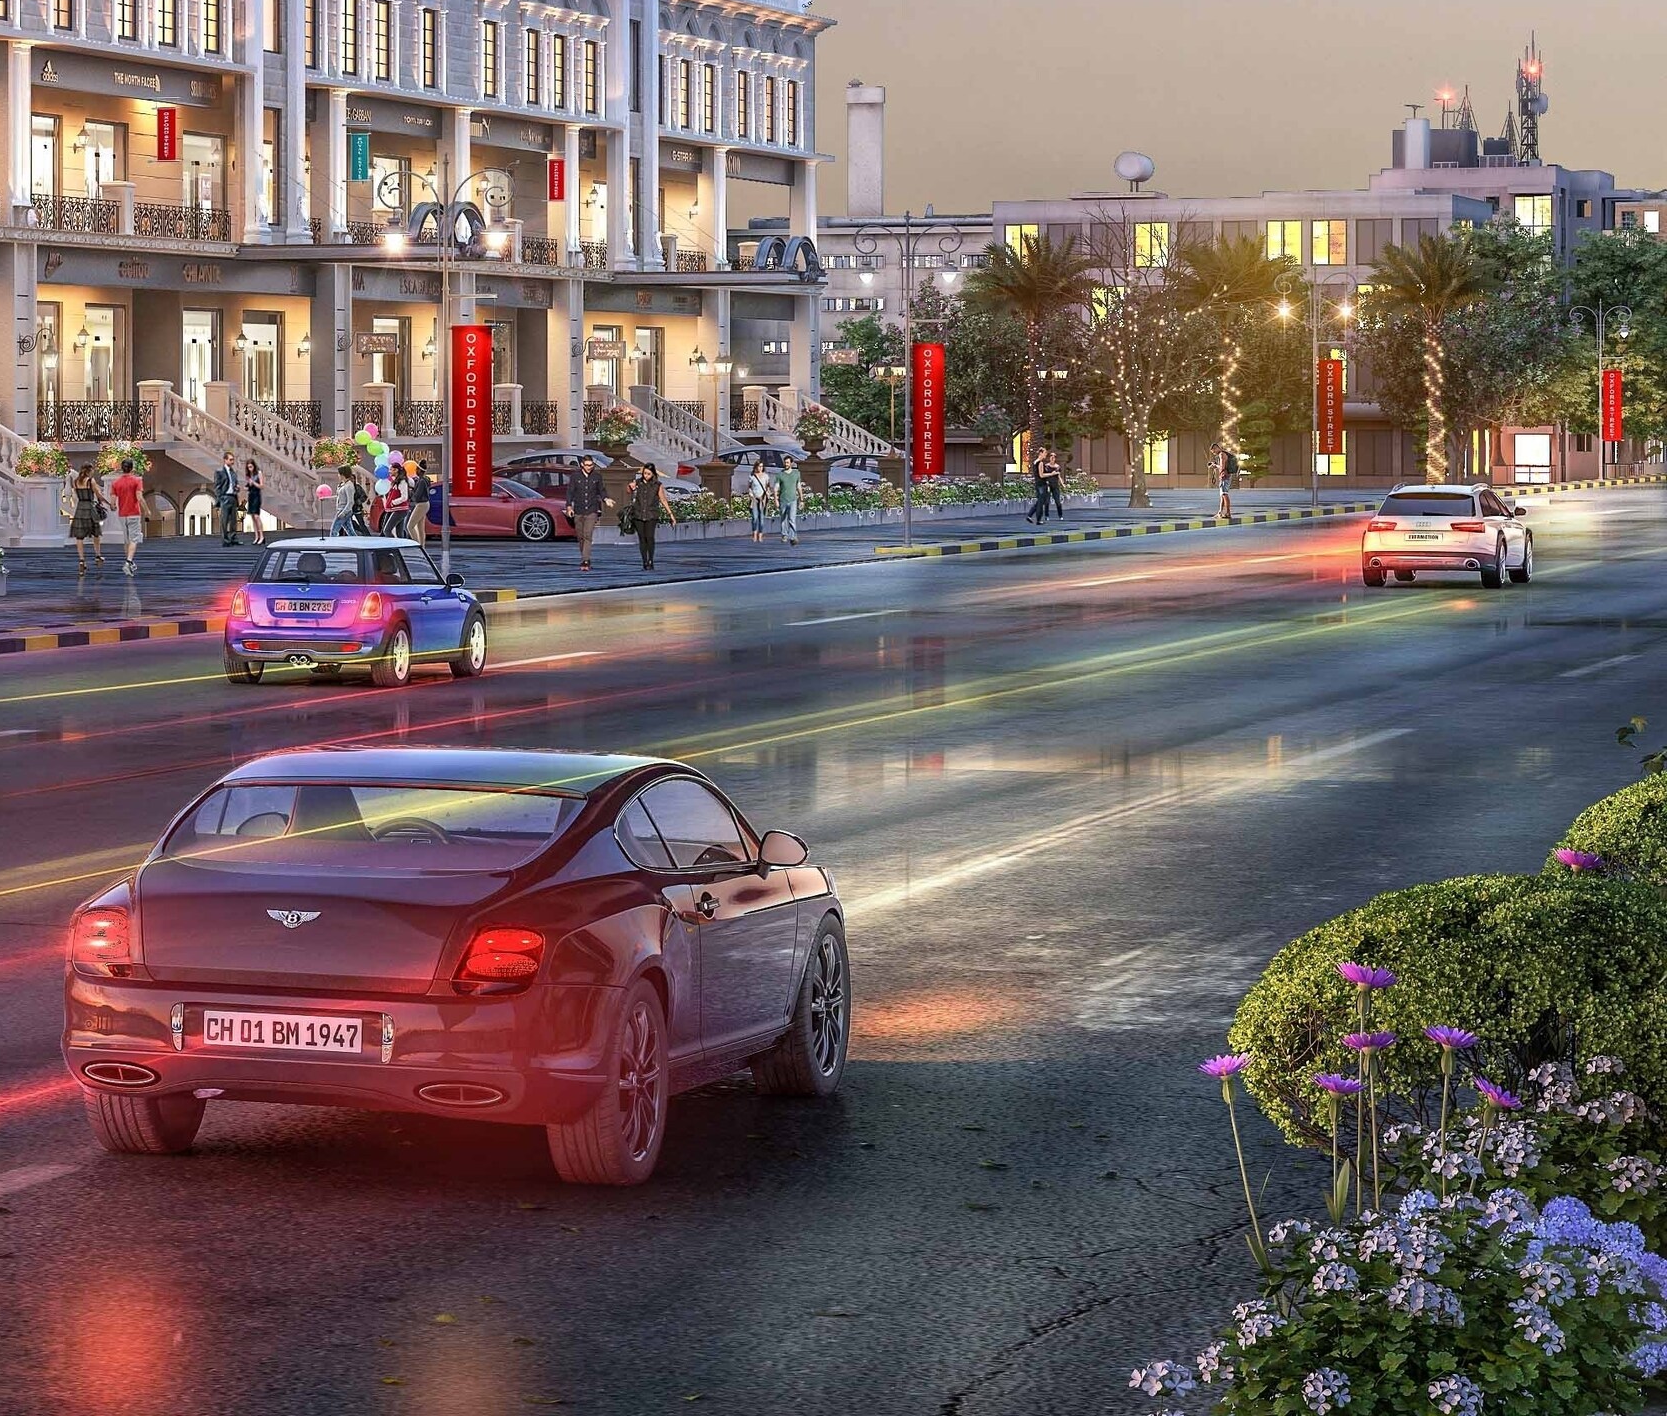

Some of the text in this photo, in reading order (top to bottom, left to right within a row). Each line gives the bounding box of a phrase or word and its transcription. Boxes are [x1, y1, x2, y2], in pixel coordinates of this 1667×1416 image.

[466, 333, 477, 490] OXFORD STREET
[924, 349, 932, 470] OXFORD STREET
[1326, 363, 1334, 451] OXFORD STREET
[287, 601, 297, 612] 01
[207, 1017, 359, 1048] CH 01 BM 1947
